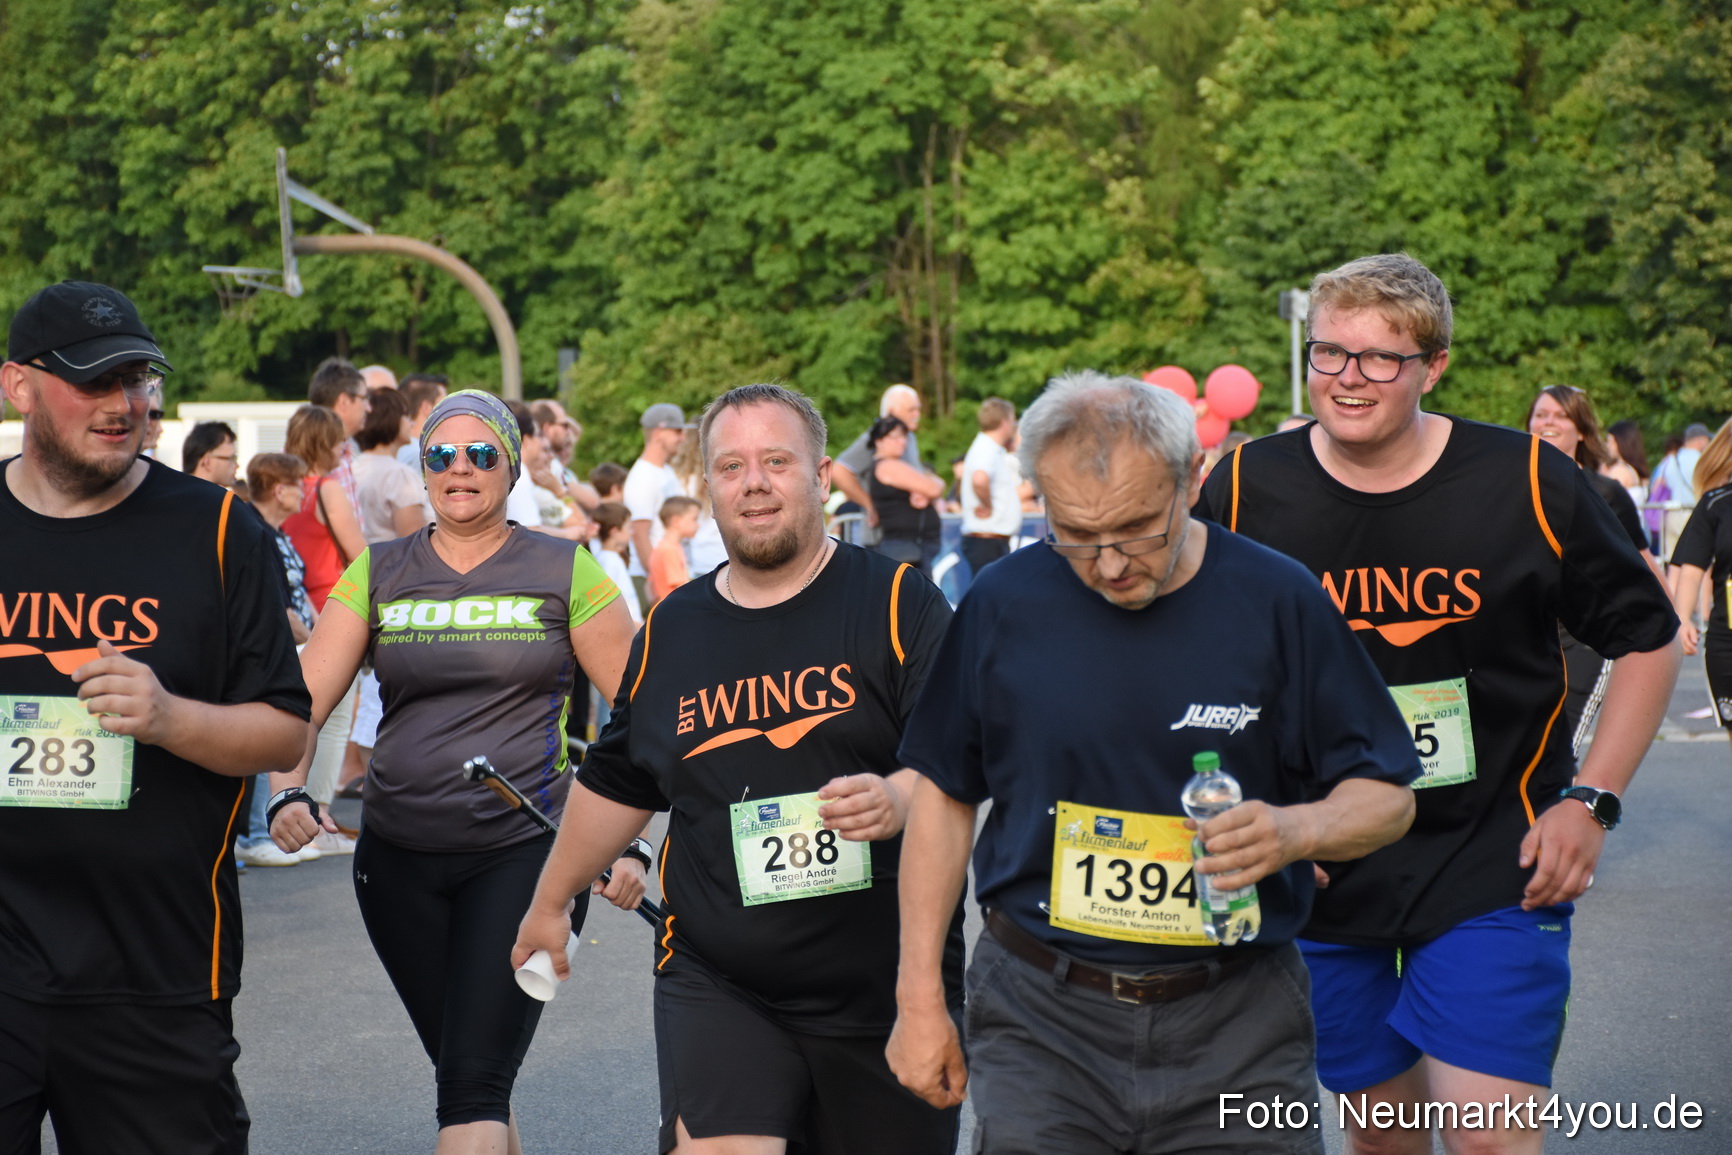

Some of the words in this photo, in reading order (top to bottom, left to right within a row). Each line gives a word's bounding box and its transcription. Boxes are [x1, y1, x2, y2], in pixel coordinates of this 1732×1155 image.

[382, 600, 537, 627] BOCK
[378, 631, 414, 646] inspired
[416, 631, 435, 644] by
[438, 631, 482, 642] smart
[485, 630, 547, 643] concepts
[697, 663, 857, 728] WINGS
[2, 717, 61, 730] firmenlauf
[676, 695, 697, 736] BIT
[1170, 702, 1241, 731] JURA
[1434, 707, 1460, 720] 2019
[7, 736, 96, 777] 283
[1422, 760, 1440, 770] ver
[8, 777, 33, 788] Ehm
[37, 778, 97, 790] Alexander
[17, 788, 58, 797] BITWINGS
[60, 789, 85, 798] GmbH
[750, 814, 802, 833] firmenlauf
[761, 829, 839, 873] 288
[1079, 832, 1149, 852] firmenlauf
[771, 871, 803, 884] Riegel
[806, 866, 837, 879] André
[775, 880, 811, 892] BITWINGS
[813, 877, 835, 887] GmbH
[1075, 854, 1198, 909] 1394
[1091, 901, 1137, 920] Forster
[1143, 908, 1181, 922] Anton
[1078, 912, 1127, 928] Lebenshilfe
[1130, 920, 1173, 933] Neumarkt
[1184, 925, 1192, 933] V
